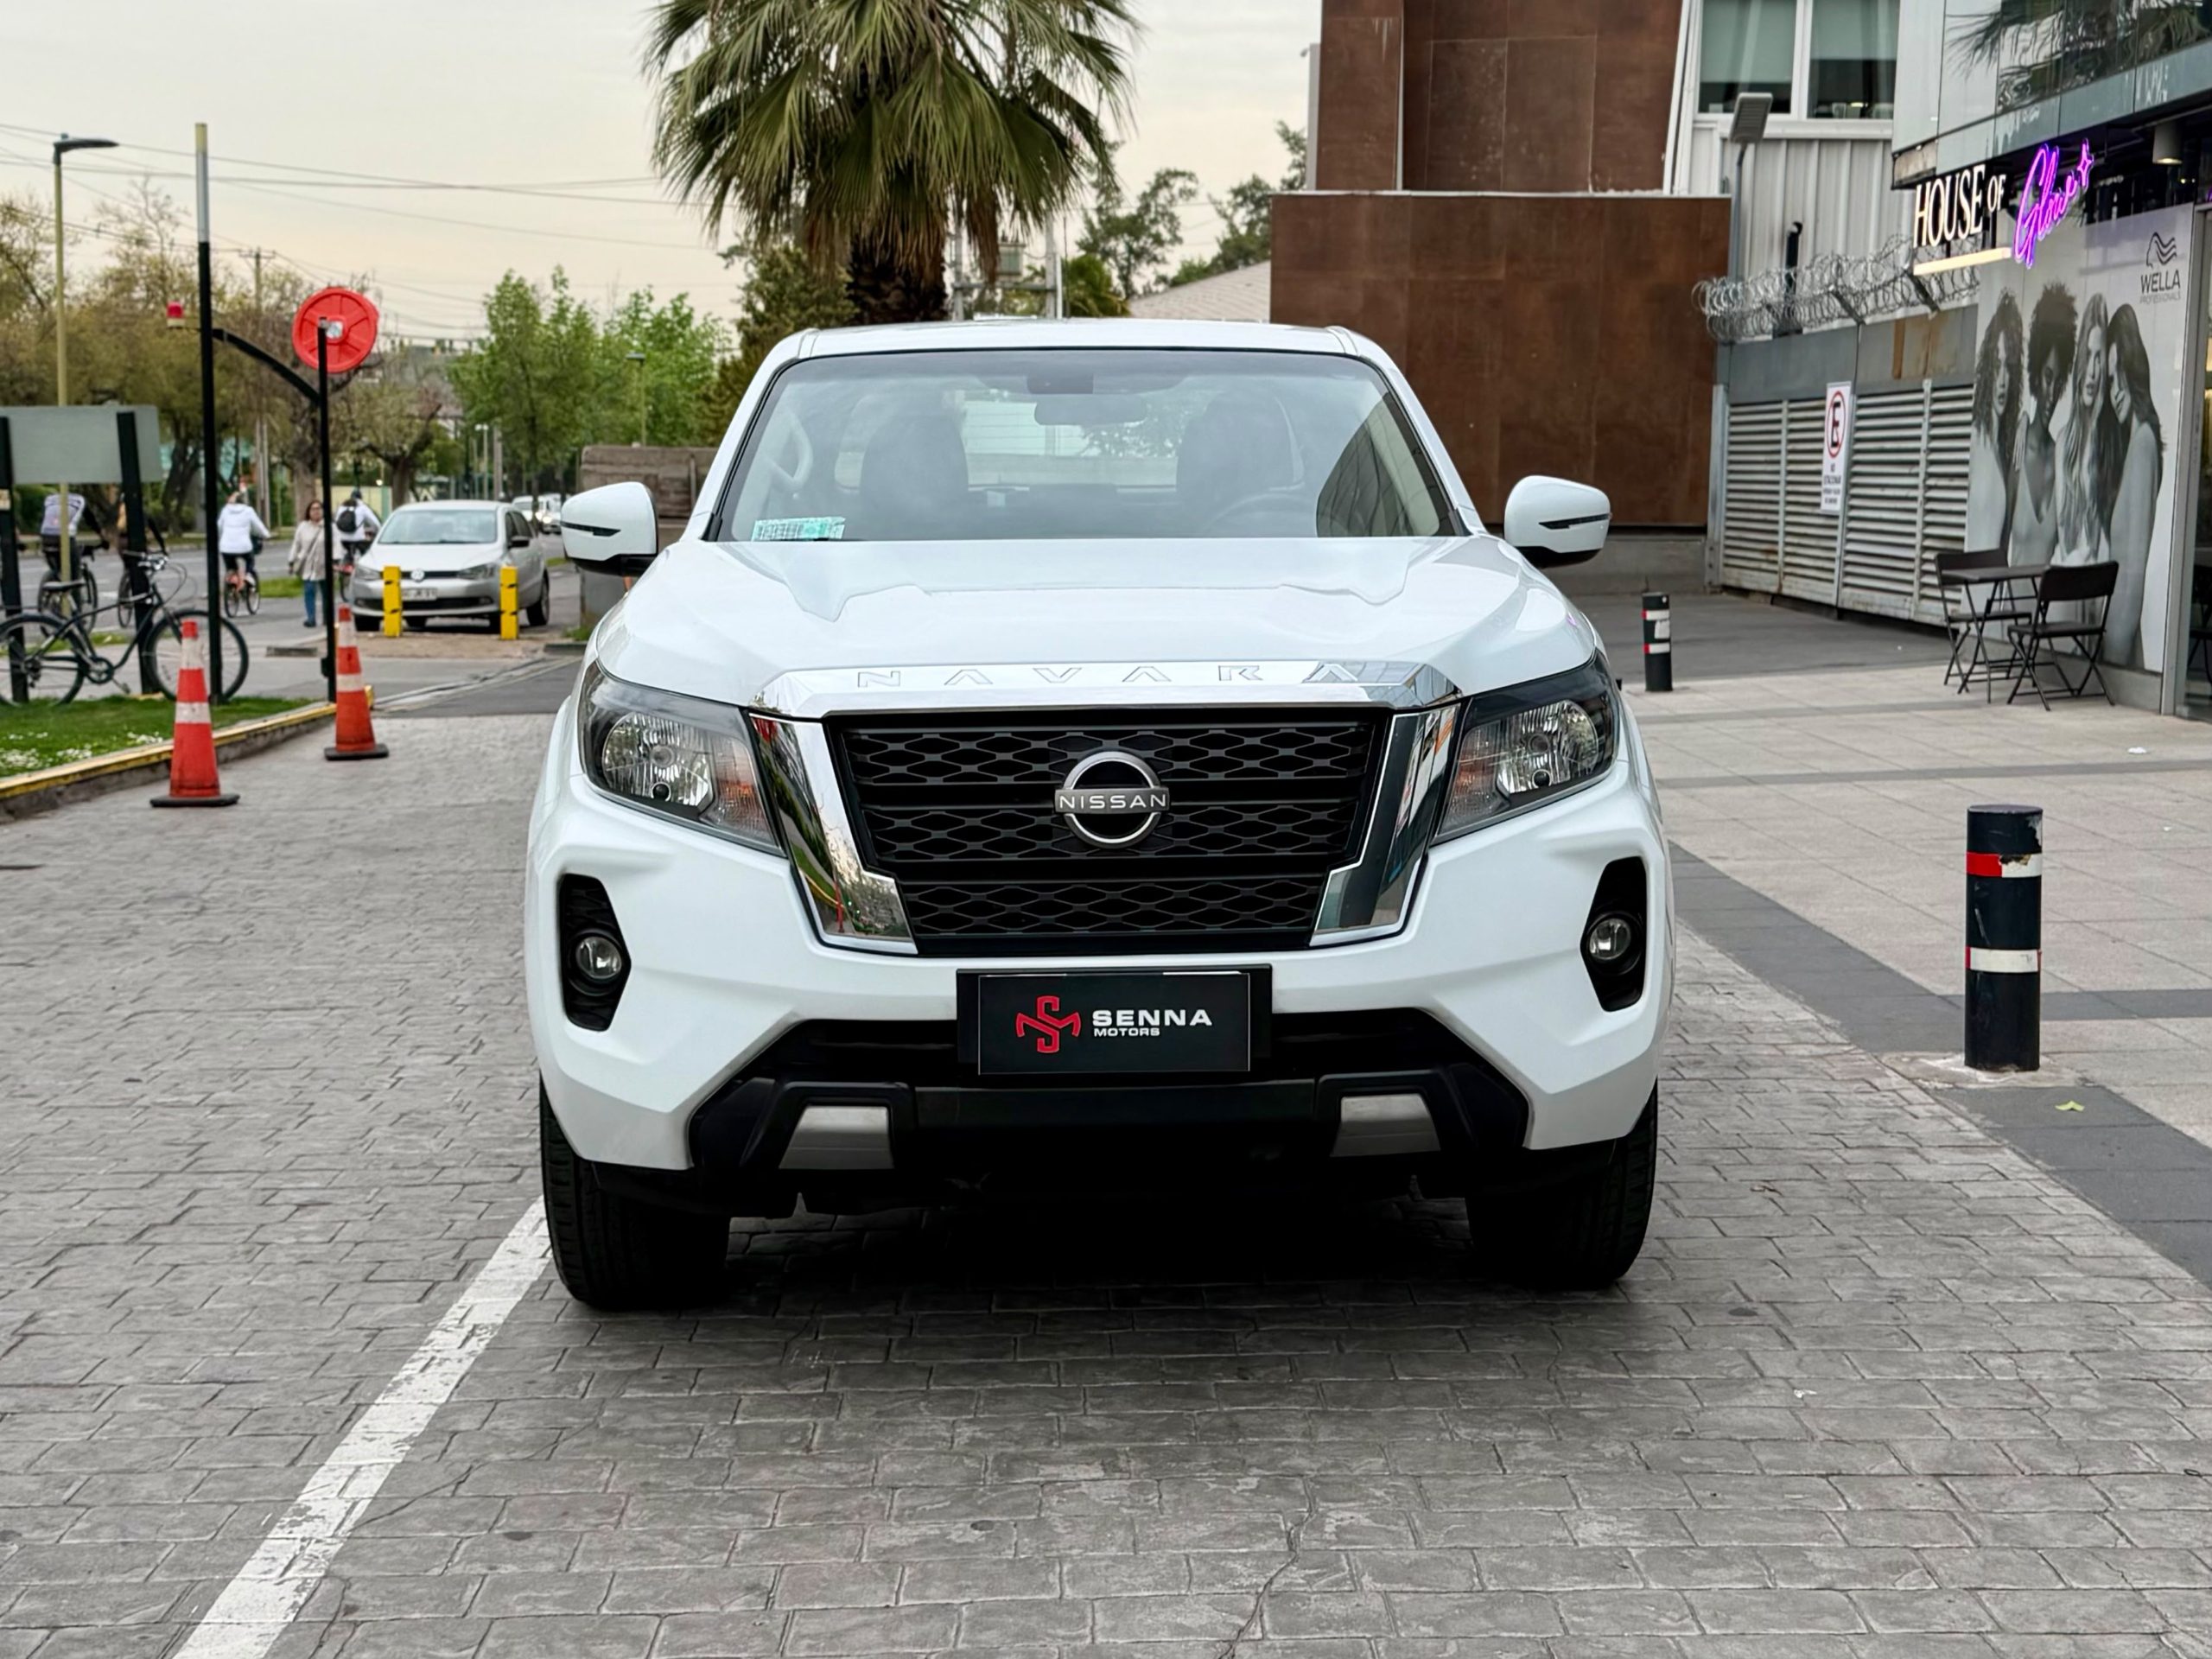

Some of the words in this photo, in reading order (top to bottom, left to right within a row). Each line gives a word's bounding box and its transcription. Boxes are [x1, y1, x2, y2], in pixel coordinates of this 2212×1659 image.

[1913, 164, 1986, 249] HOUSE
[1987, 174, 2006, 213] OF
[2140, 269, 2181, 294] WELLA
[857, 663, 1358, 688] NAVARA
[1059, 794, 1166, 809] NISSAN
[1092, 1009, 1212, 1027] SENNA
[1094, 1027, 1160, 1037] MOTORS
